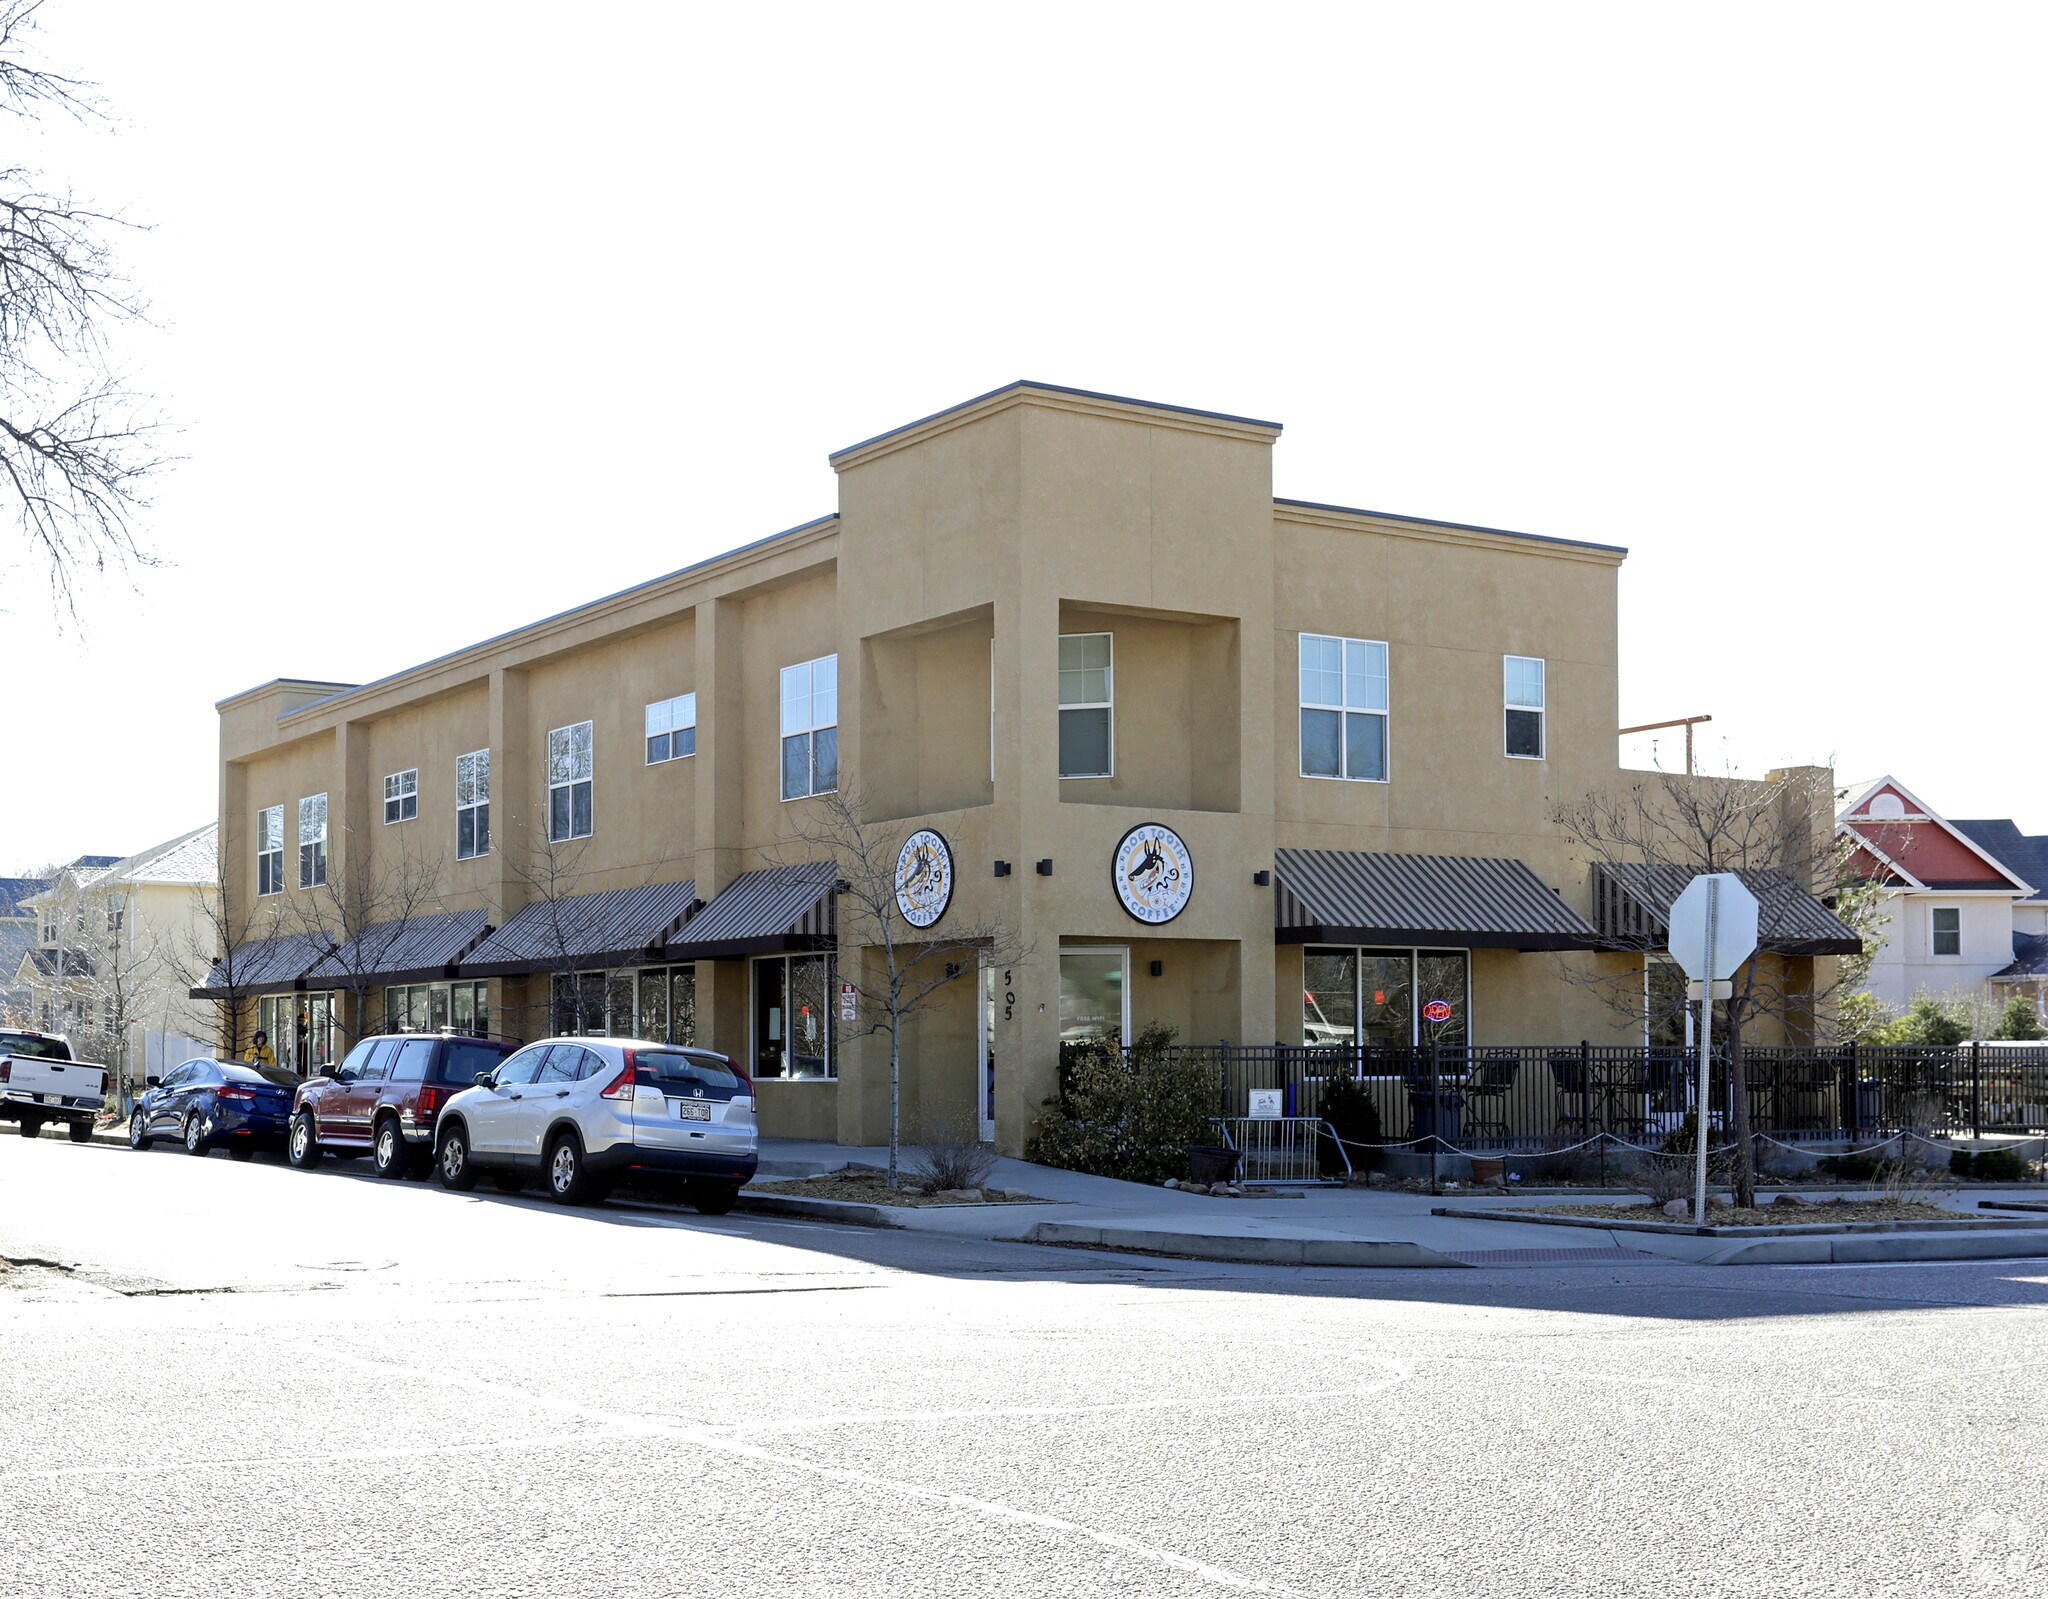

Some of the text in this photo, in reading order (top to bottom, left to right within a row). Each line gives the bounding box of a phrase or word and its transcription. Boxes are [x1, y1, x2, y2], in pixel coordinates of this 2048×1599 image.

[901, 834, 946, 863] DOG TOOTH
[1123, 828, 1186, 859] DOG TOOTH
[906, 907, 939, 923] COFFEE
[1131, 901, 1177, 920] COFFEE
[1004, 970, 1015, 1020] 505
[1423, 1005, 1451, 1018] OPEN
